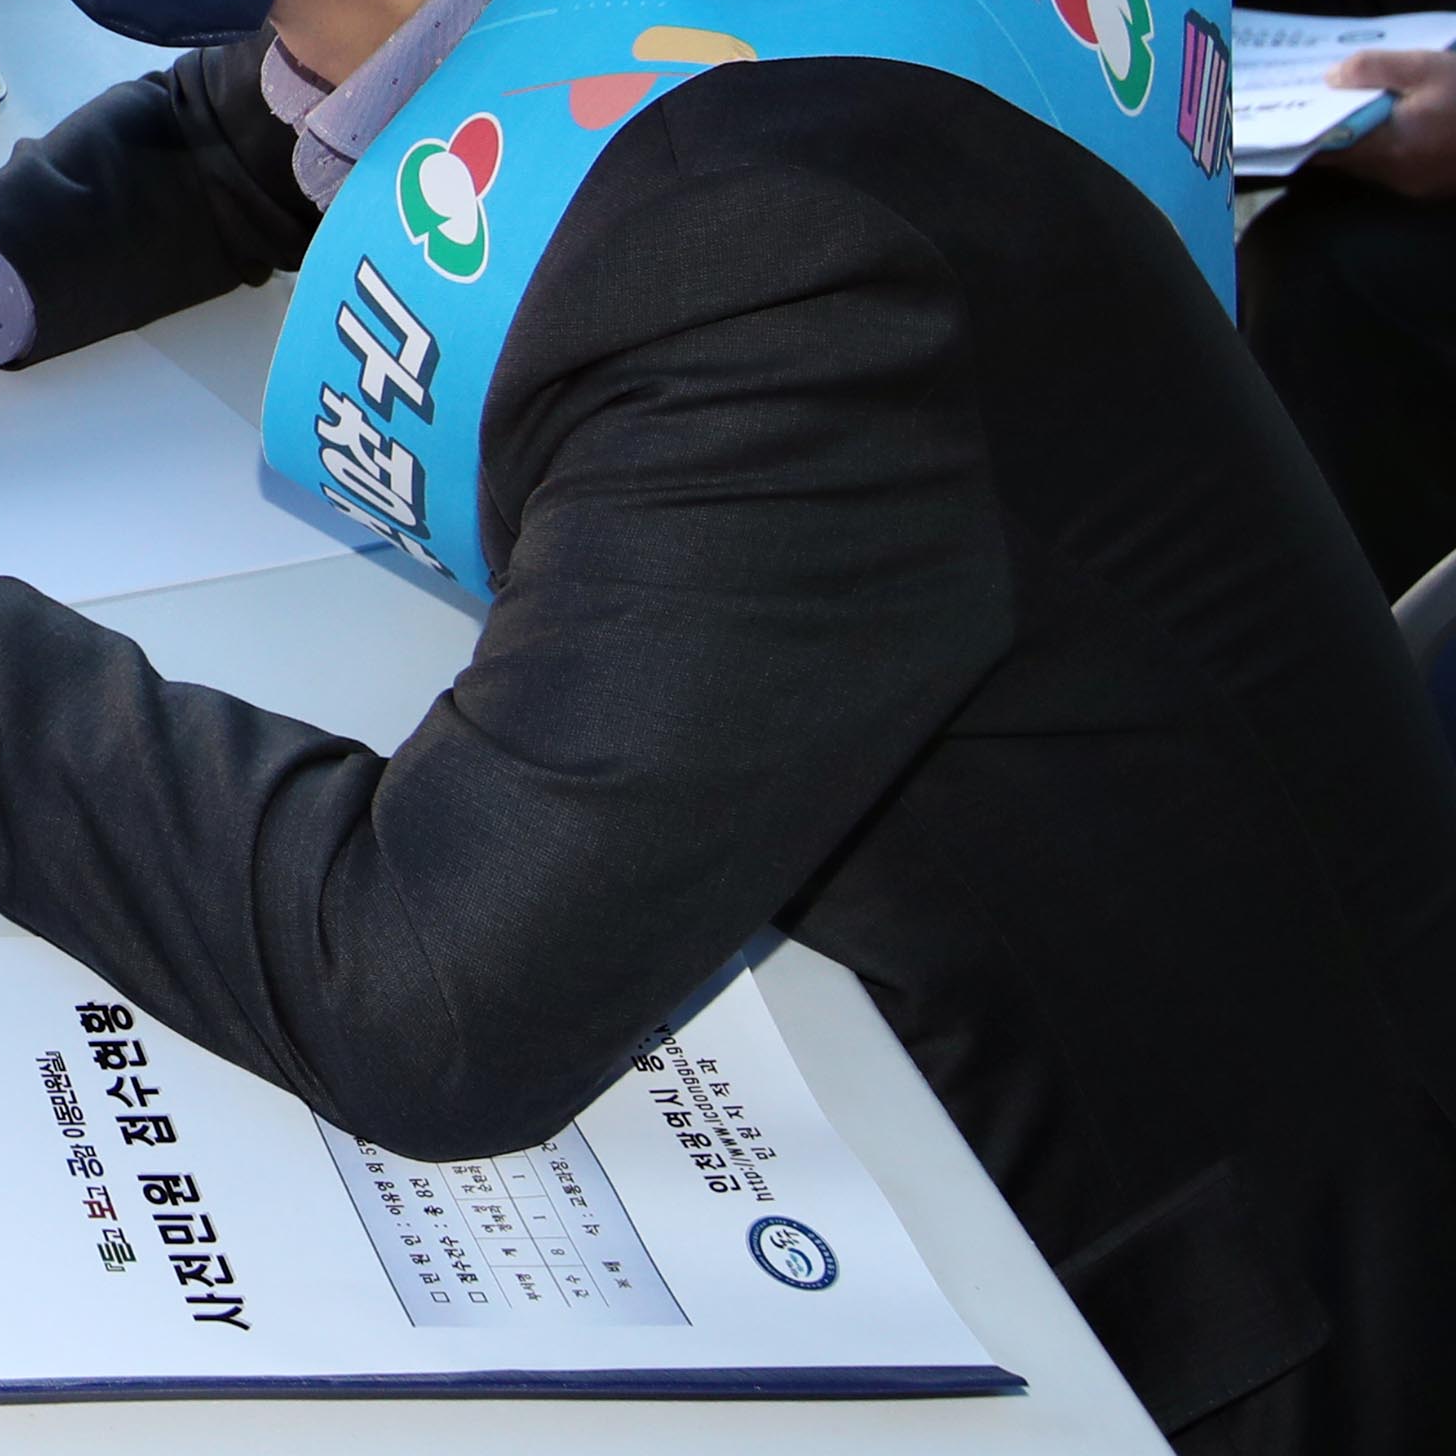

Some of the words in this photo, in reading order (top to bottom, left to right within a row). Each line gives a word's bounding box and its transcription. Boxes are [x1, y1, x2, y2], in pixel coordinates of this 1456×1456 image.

[75, 1001, 178, 1146] 접수현황
[66, 1144, 104, 1178] 공감
[648, 1088, 741, 1193] 인천광역시
[82, 1185, 118, 1221] 보고
[137, 1173, 251, 1332] 사전민원
[439, 1235, 478, 1284] 접수건수
